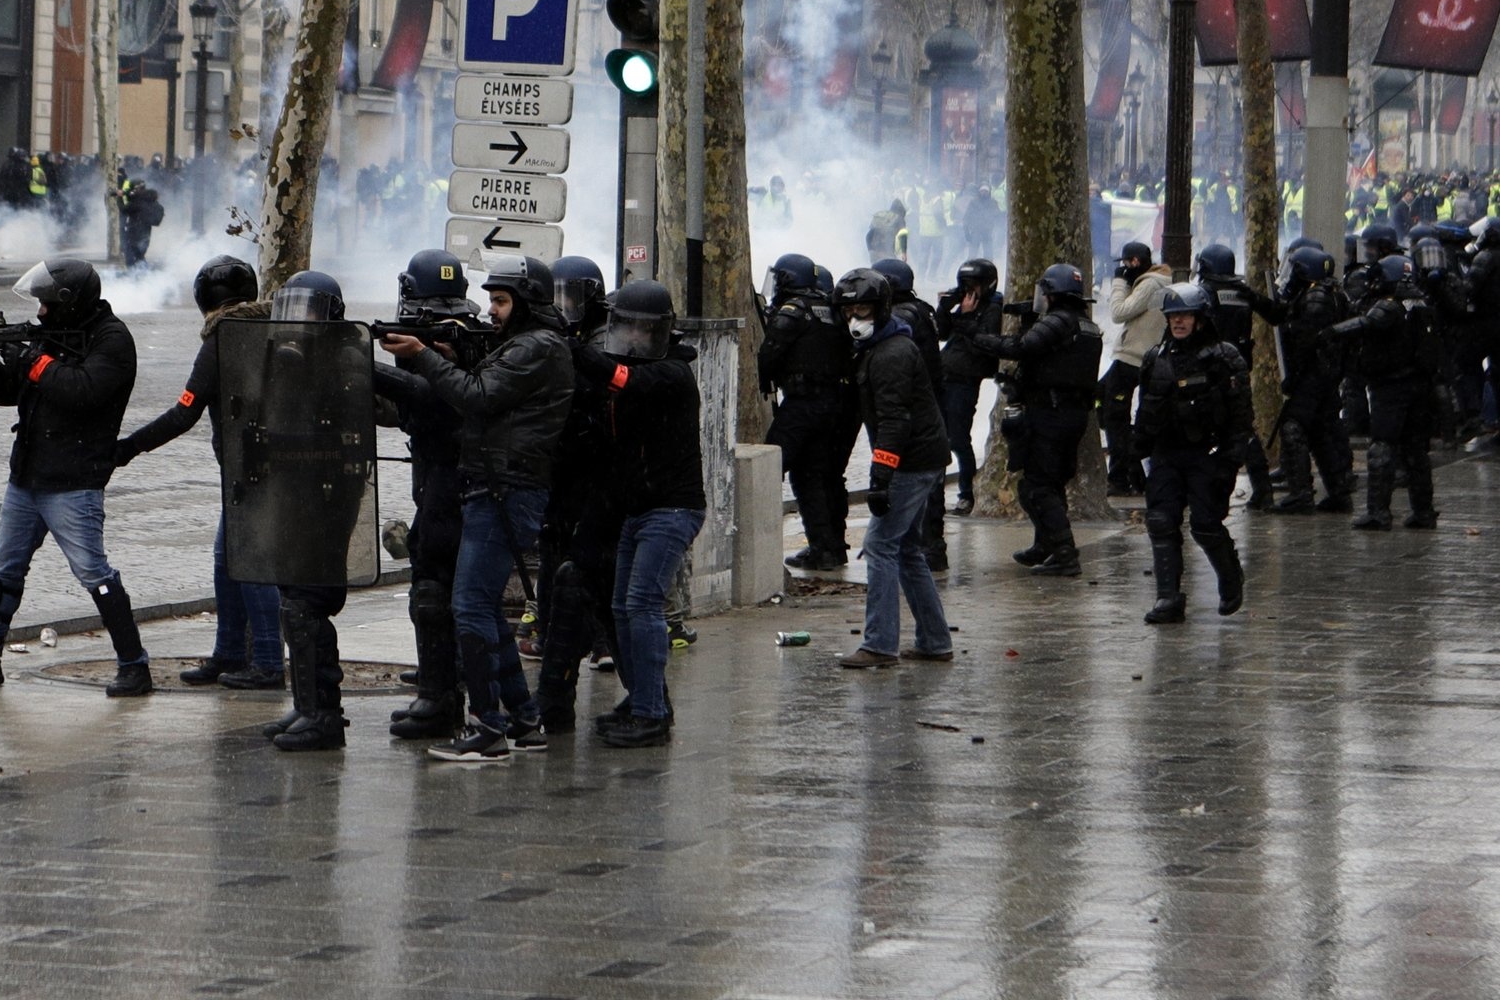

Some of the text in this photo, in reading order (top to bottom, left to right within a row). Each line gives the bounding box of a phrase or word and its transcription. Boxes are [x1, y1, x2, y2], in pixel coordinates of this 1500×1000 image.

[483, 81, 541, 98] CHAMPS
[481, 97, 540, 116] ÉLYSÉES
[524, 158, 556, 168] MACRON
[480, 178, 531, 196] PIERRE
[471, 195, 538, 214] CHARRON
[628, 247, 646, 259] PCF
[443, 267, 452, 278] B
